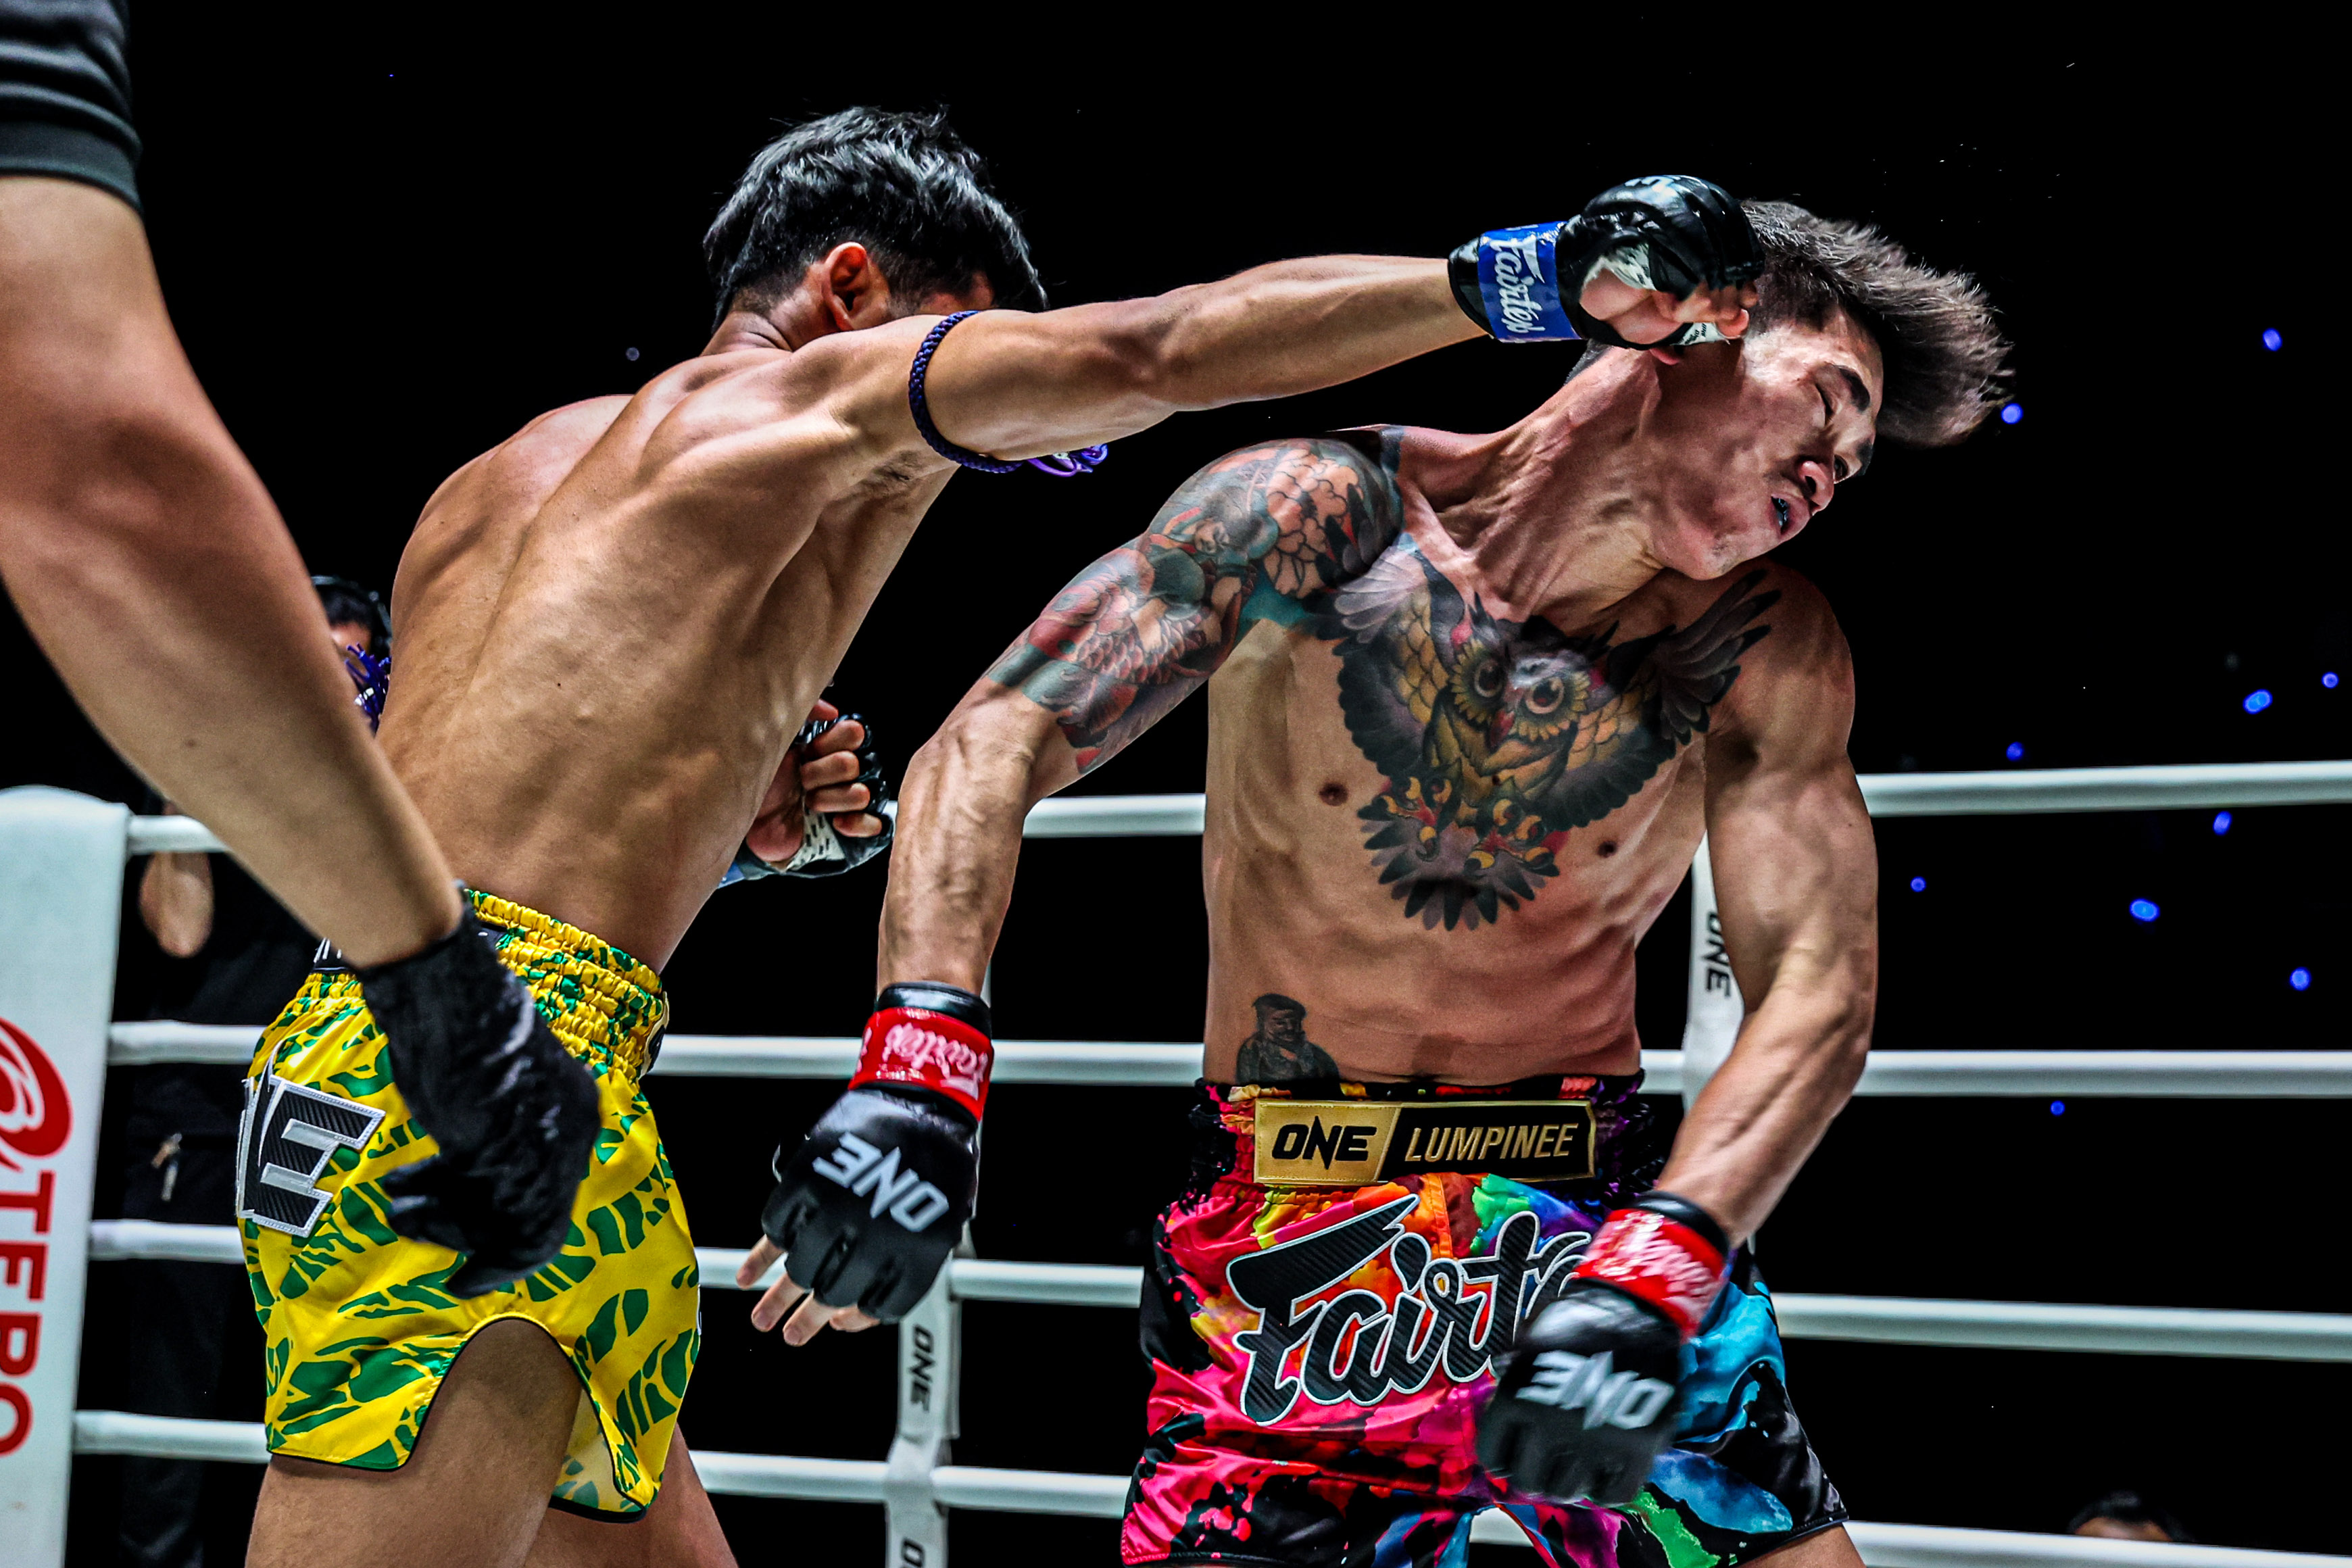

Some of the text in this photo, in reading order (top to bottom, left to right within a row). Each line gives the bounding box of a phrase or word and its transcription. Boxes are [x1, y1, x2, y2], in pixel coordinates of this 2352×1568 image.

[812, 1130, 950, 1233] ONE
[1271, 1116, 1579, 1170] ONE LUMPINEE
[909, 1324, 936, 1413] ONE
[1515, 1349, 1675, 1431] ONE
